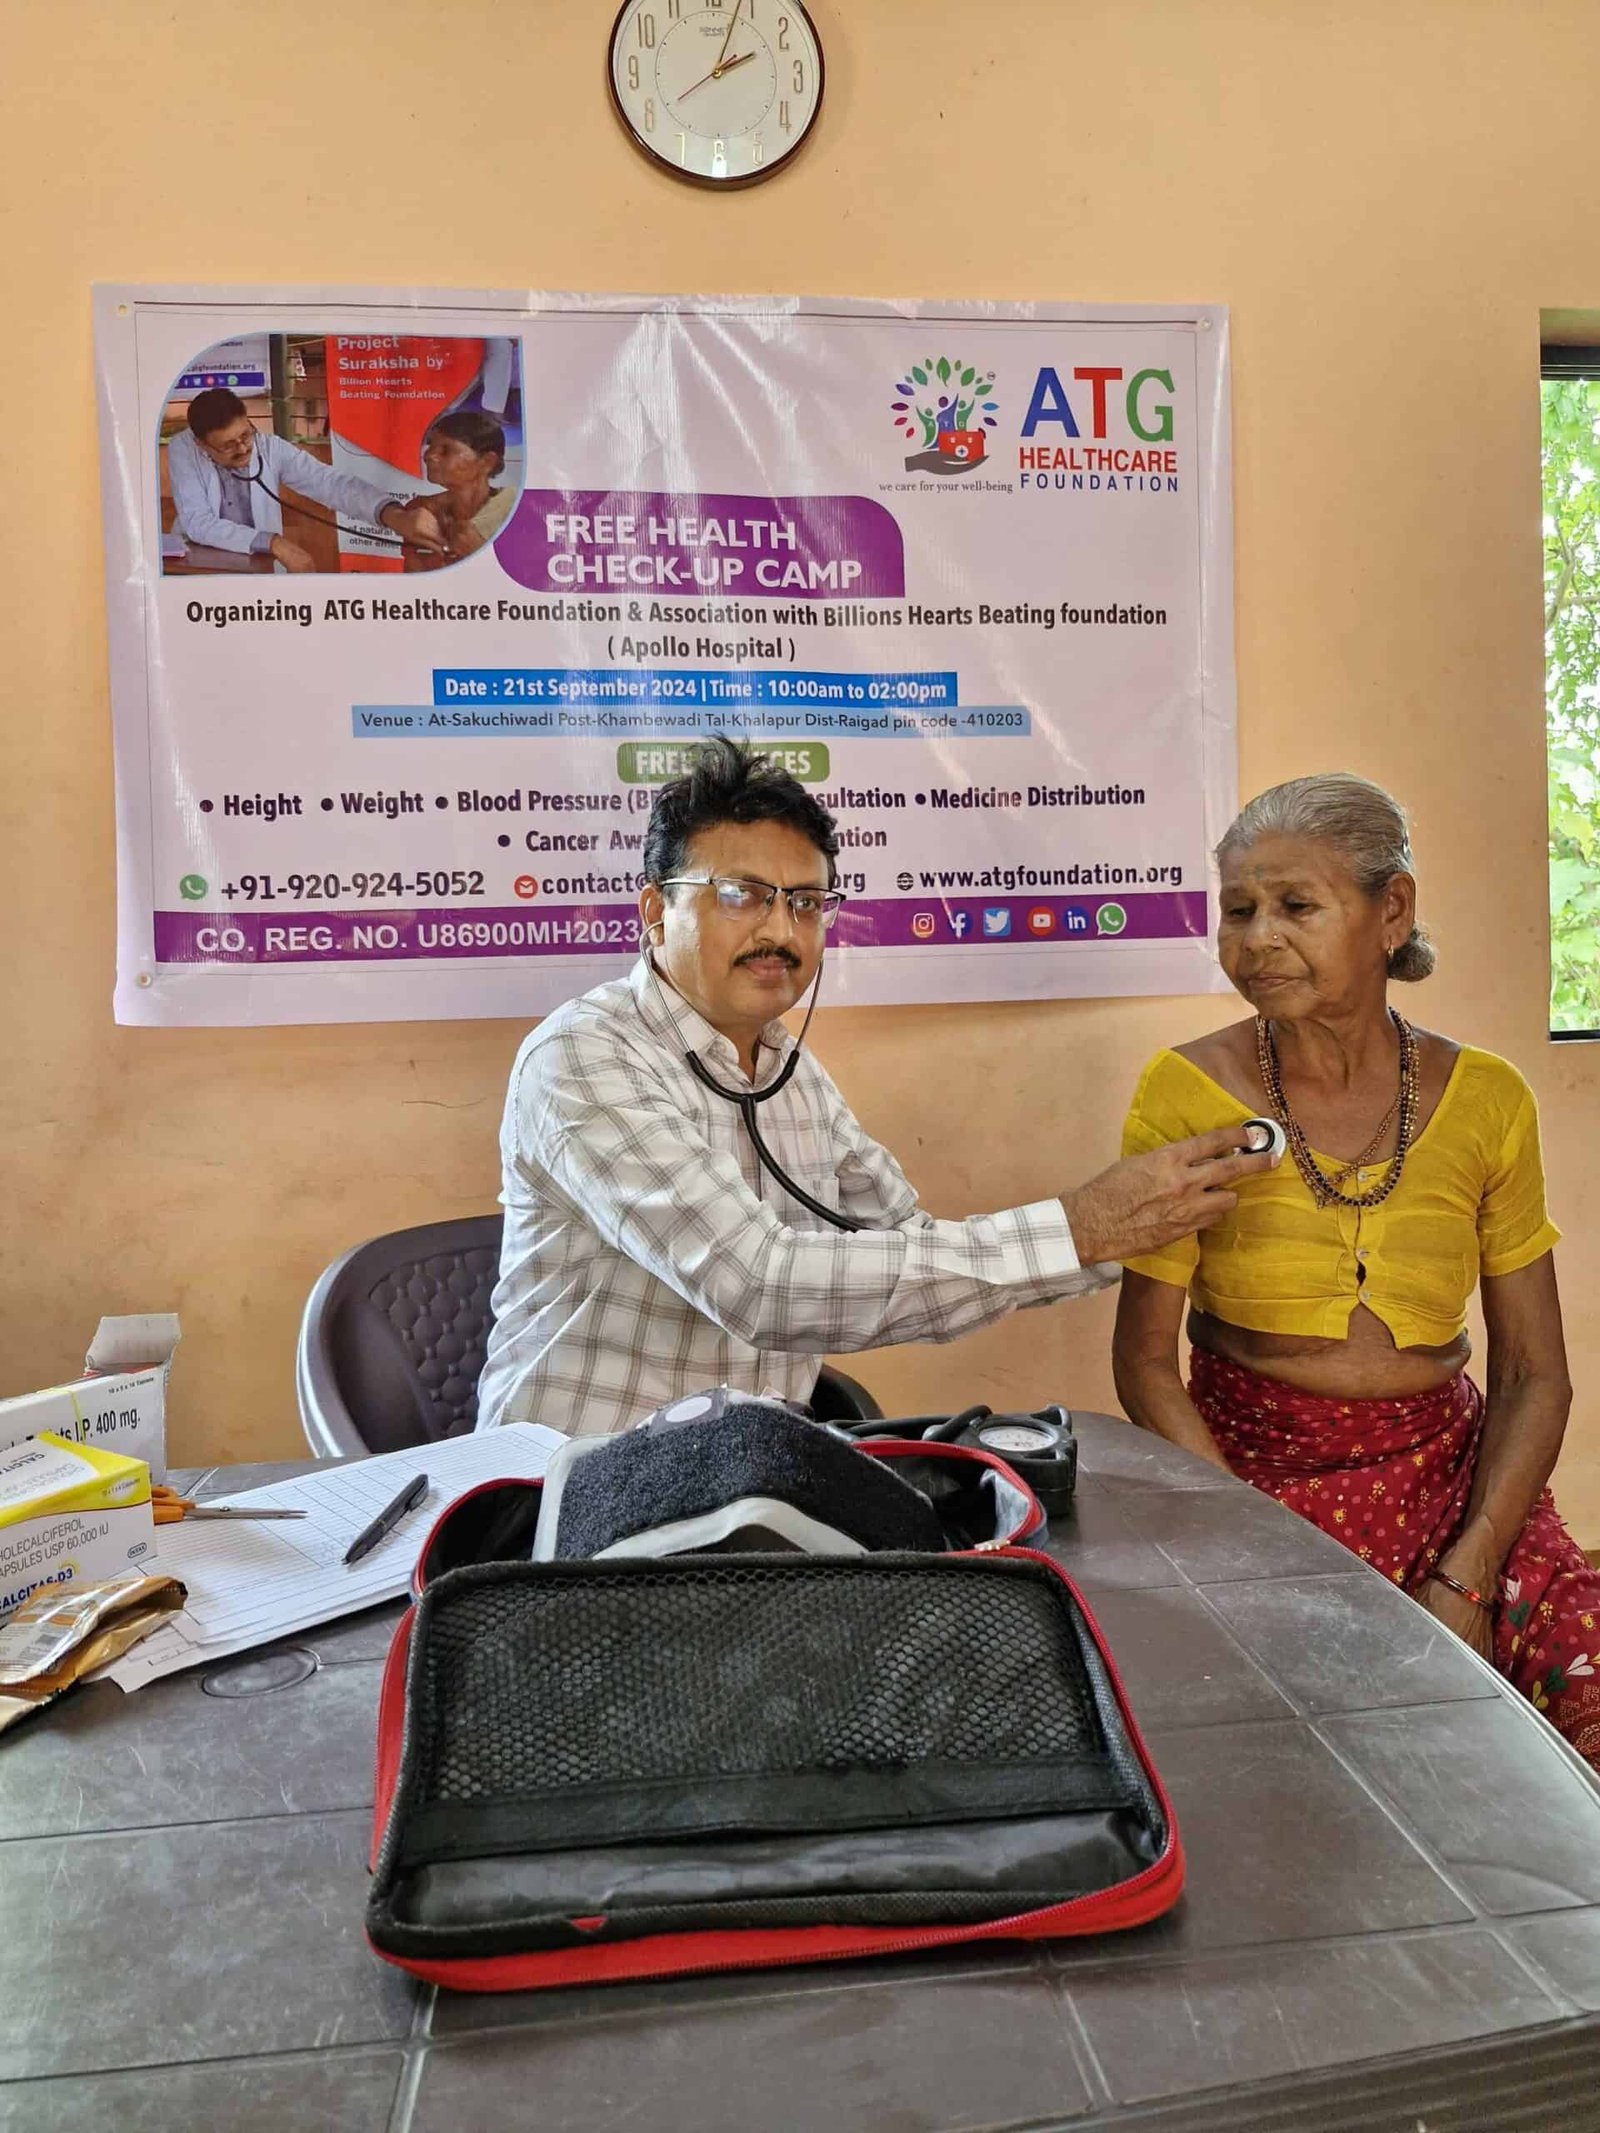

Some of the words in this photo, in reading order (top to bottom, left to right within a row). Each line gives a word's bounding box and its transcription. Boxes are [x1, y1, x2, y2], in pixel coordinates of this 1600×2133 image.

[637, 12, 656, 49] 10
[778, 16, 790, 51] 2
[628, 55, 639, 90] 9
[792, 59, 804, 93] 3
[644, 98, 655, 133] 8
[780, 100, 792, 133] 4
[674, 132, 686, 166] 7
[752, 132, 763, 166] 5
[337, 336, 400, 351] Project
[339, 356, 419, 370] Suraksha
[426, 355, 443, 370] by
[339, 377, 372, 386] Billion
[375, 377, 413, 386] Hearts
[340, 390, 380, 400] Beating
[384, 389, 446, 399] Foundation
[1020, 367, 1176, 442] ATG
[1019, 447, 1178, 473] HEALTHCARE
[878, 483, 893, 492] we
[895, 483, 917, 492] care
[919, 480, 935, 492] for
[936, 483, 959, 494] your
[961, 480, 1013, 494] well-being
[1020, 473, 1178, 492] FOUNDATION
[546, 513, 636, 545] FREE
[649, 517, 796, 551] HEALTH
[547, 555, 744, 587] CHECK-UP
[755, 559, 862, 590] CAMP
[186, 599, 312, 628] Organizing
[324, 600, 365, 621] ATG
[372, 599, 491, 621] Healthcare
[497, 600, 621, 622] Foundation
[628, 601, 642, 622] &
[649, 602, 767, 624] Association
[773, 602, 818, 626] with
[824, 606, 902, 628] Billions
[908, 605, 973, 626] Hearts
[979, 604, 1055, 629] Beating
[1060, 603, 1167, 625] foundation
[621, 636, 690, 663] Apollo
[696, 637, 782, 664] Hospital
[445, 678, 487, 697] Date
[503, 678, 544, 697] 21st
[548, 678, 647, 701] September
[651, 679, 696, 697] 2024
[709, 679, 752, 697] Time
[768, 680, 843, 699] 10:00am
[847, 684, 864, 699] to
[868, 681, 947, 703] 02:00pm
[361, 713, 413, 727] Venue
[428, 713, 553, 727] At-Sakuchiwadi
[558, 713, 701, 727] Post-Khambewadi
[705, 713, 800, 729] Tal-Khalapur
[805, 714, 888, 731] Dist-Raigad
[893, 715, 916, 731] pin
[921, 714, 957, 728] code
[961, 713, 1023, 727] -410203
[636, 751, 694, 774] FREE
[223, 794, 302, 821] Height
[341, 791, 424, 819] Weight
[457, 789, 521, 812] Blood
[529, 790, 622, 812] Pressure
[808, 787, 906, 808] sultation
[930, 788, 1022, 809] Medicine
[1027, 785, 1145, 807] Distribution
[526, 830, 599, 851] Cancer
[221, 871, 485, 900] +91-920-924-5052
[541, 872, 648, 894] contact@
[833, 872, 866, 893] org
[920, 864, 1183, 890] www.atgfoundation.org
[196, 927, 254, 951] CO.
[265, 926, 343, 950] REG.
[353, 924, 408, 949] NO.
[418, 919, 640, 948] U86900MH2023
[96, 1410, 116, 1434] 400
[120, 1408, 140, 1430] mg.
[45, 1541, 65, 1559] USP
[100, 1522, 109, 1536] IU
